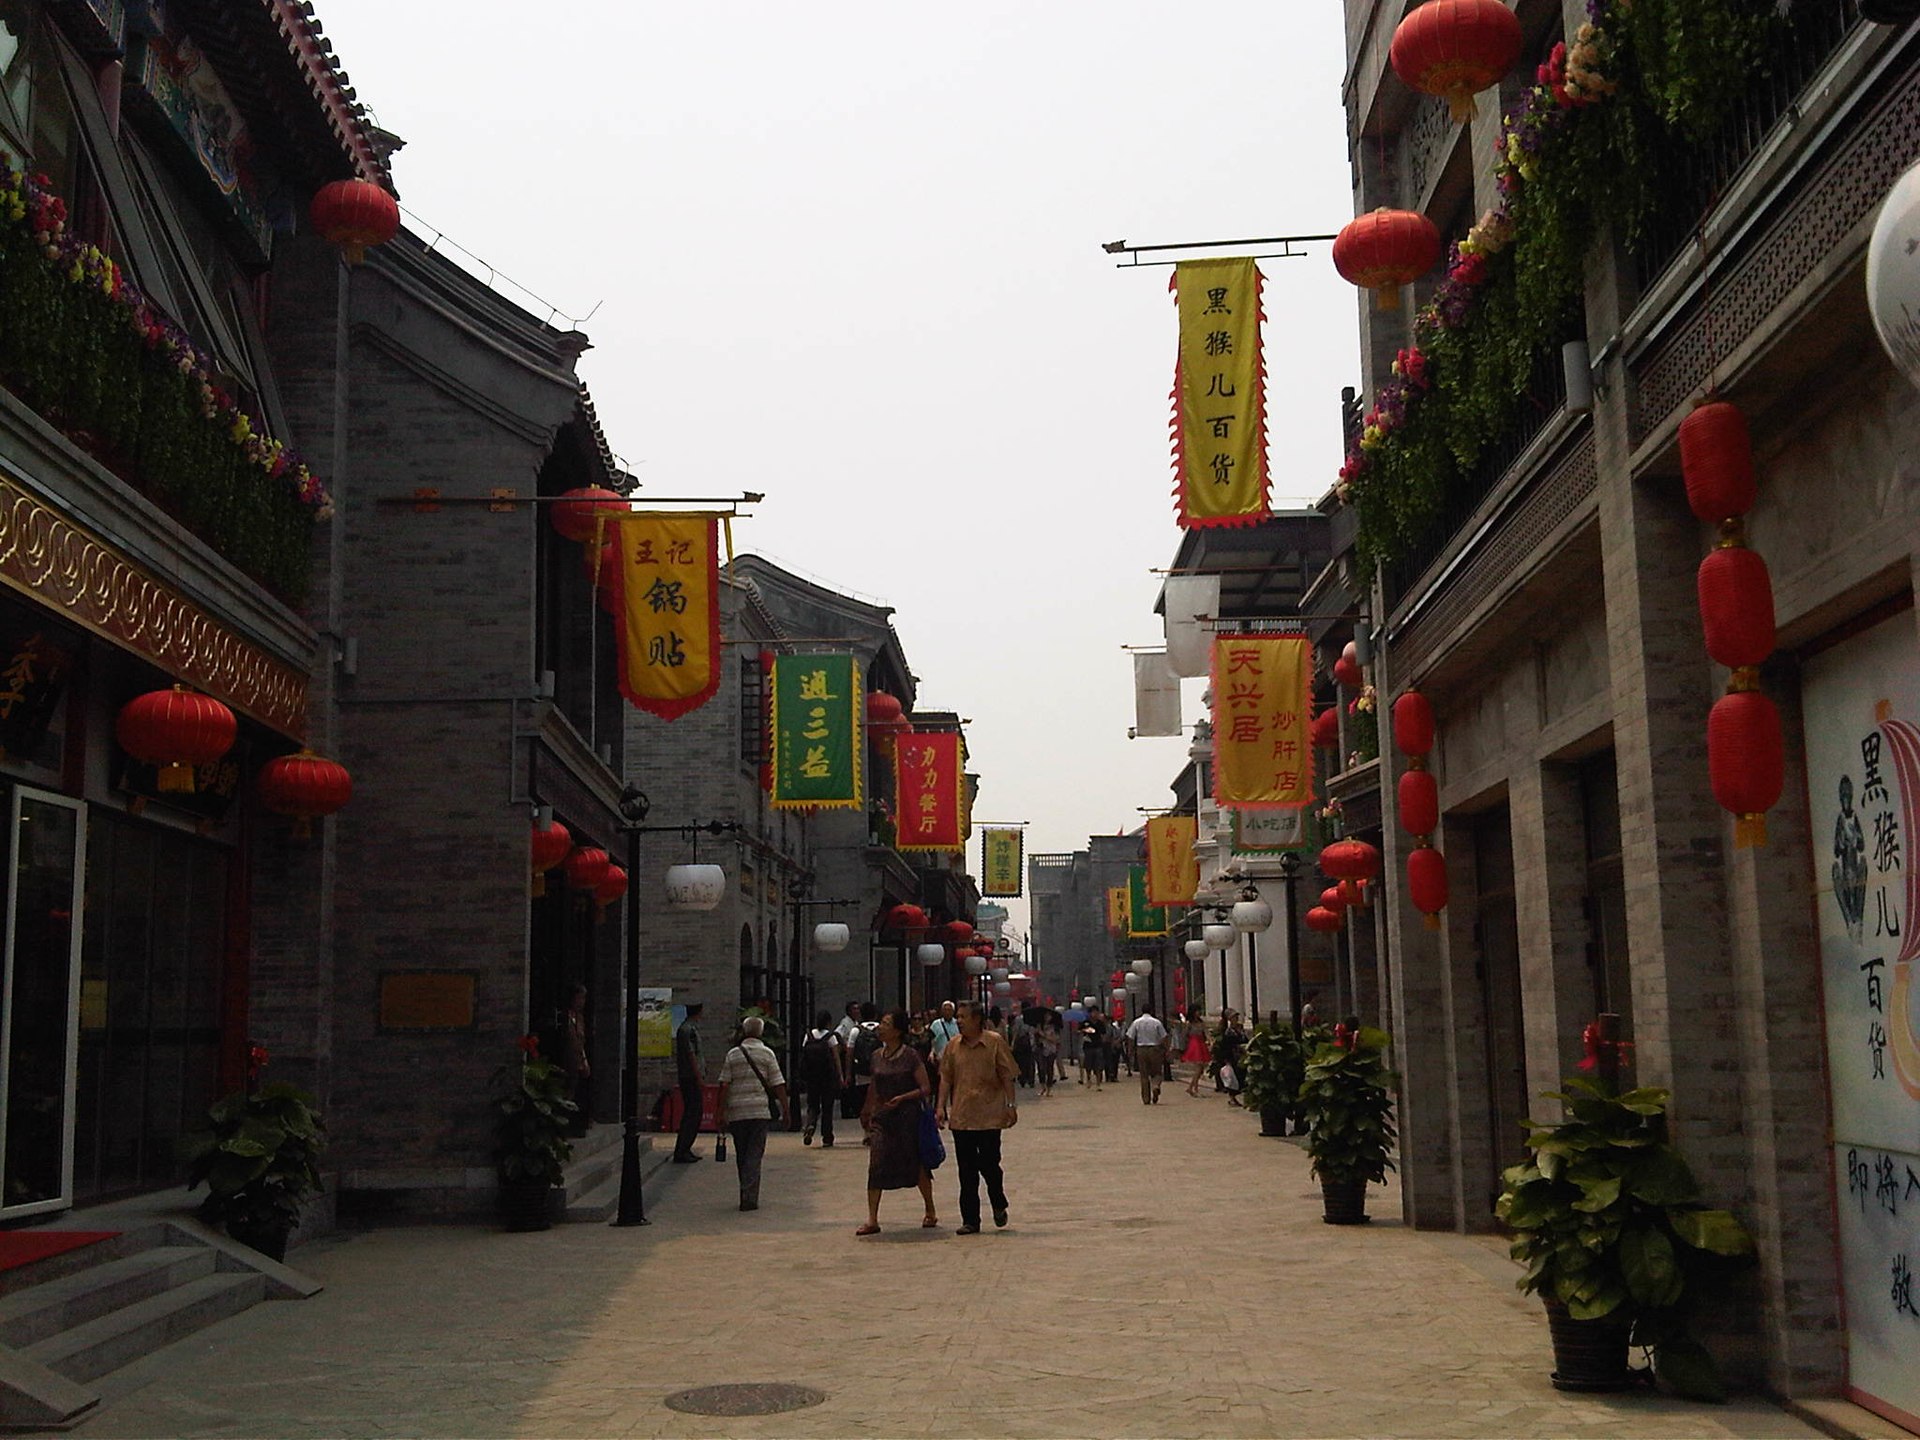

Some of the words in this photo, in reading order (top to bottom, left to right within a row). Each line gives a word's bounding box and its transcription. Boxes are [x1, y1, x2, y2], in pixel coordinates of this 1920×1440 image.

[1202, 287, 1236, 485] 黑猴儿百货
[635, 539, 695, 565] 王记
[642, 576, 688, 668] 锅贴
[1227, 649, 1264, 743] 天兴居
[919, 746, 937, 833] 力力餐厅
[1272, 711, 1298, 791] 炒肝店
[1246, 814, 1297, 832] 小吃店
[1860, 730, 1901, 1081] 黑猴儿百货
